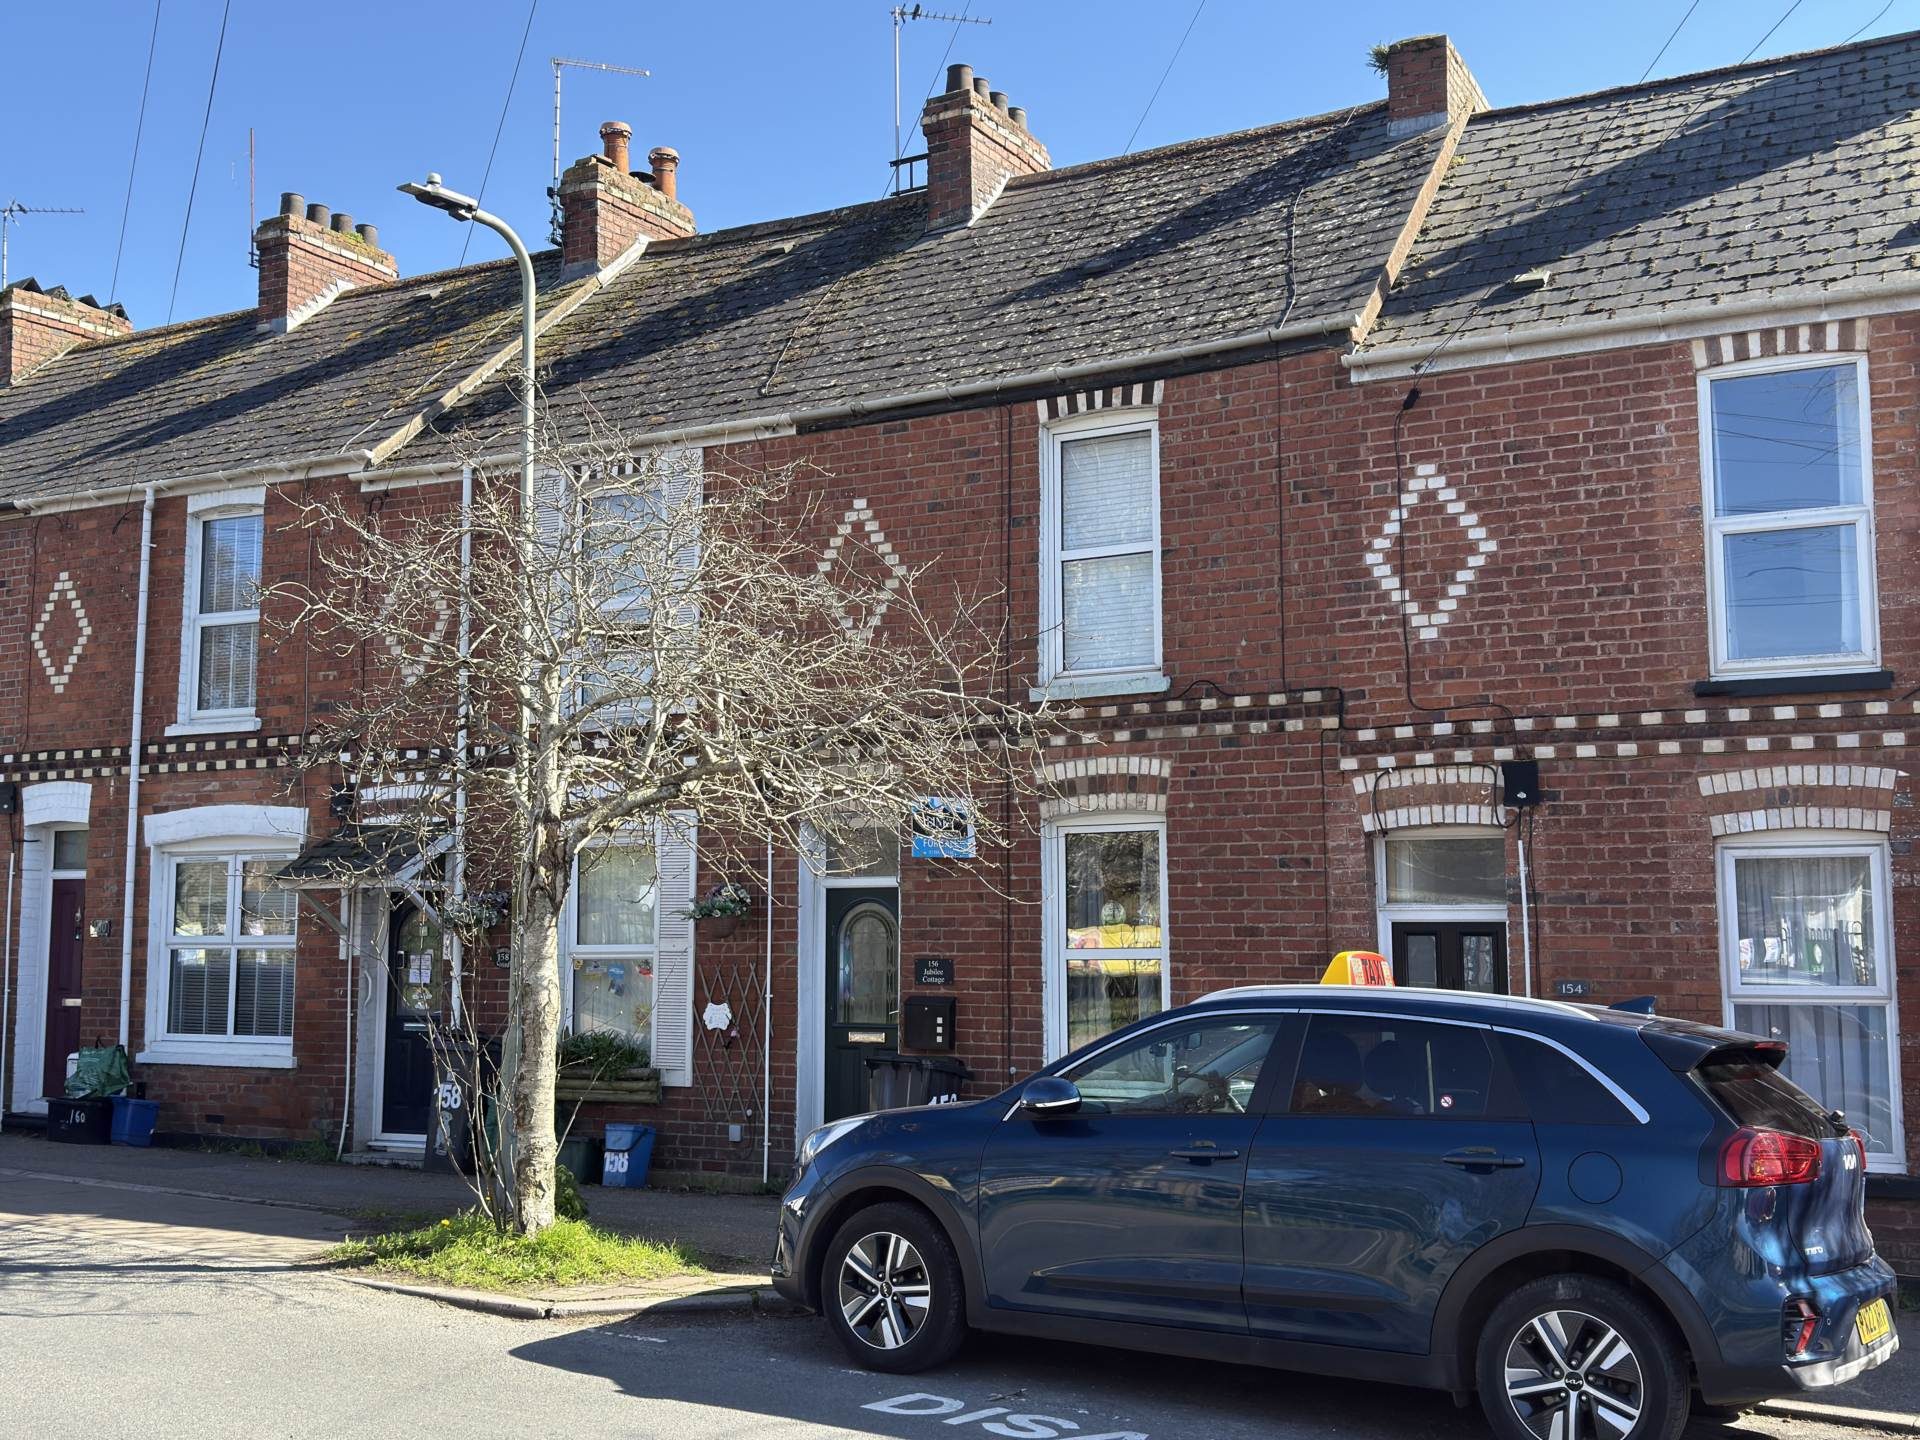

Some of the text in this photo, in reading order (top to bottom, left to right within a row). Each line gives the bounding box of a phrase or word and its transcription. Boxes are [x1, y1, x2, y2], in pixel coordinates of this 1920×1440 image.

[923, 968, 944, 976] Jubilee
[1360, 958, 1386, 985] TAXI
[922, 976, 945, 985] Cottage
[1562, 983, 1584, 994] 154
[604, 1151, 629, 1173] 158
